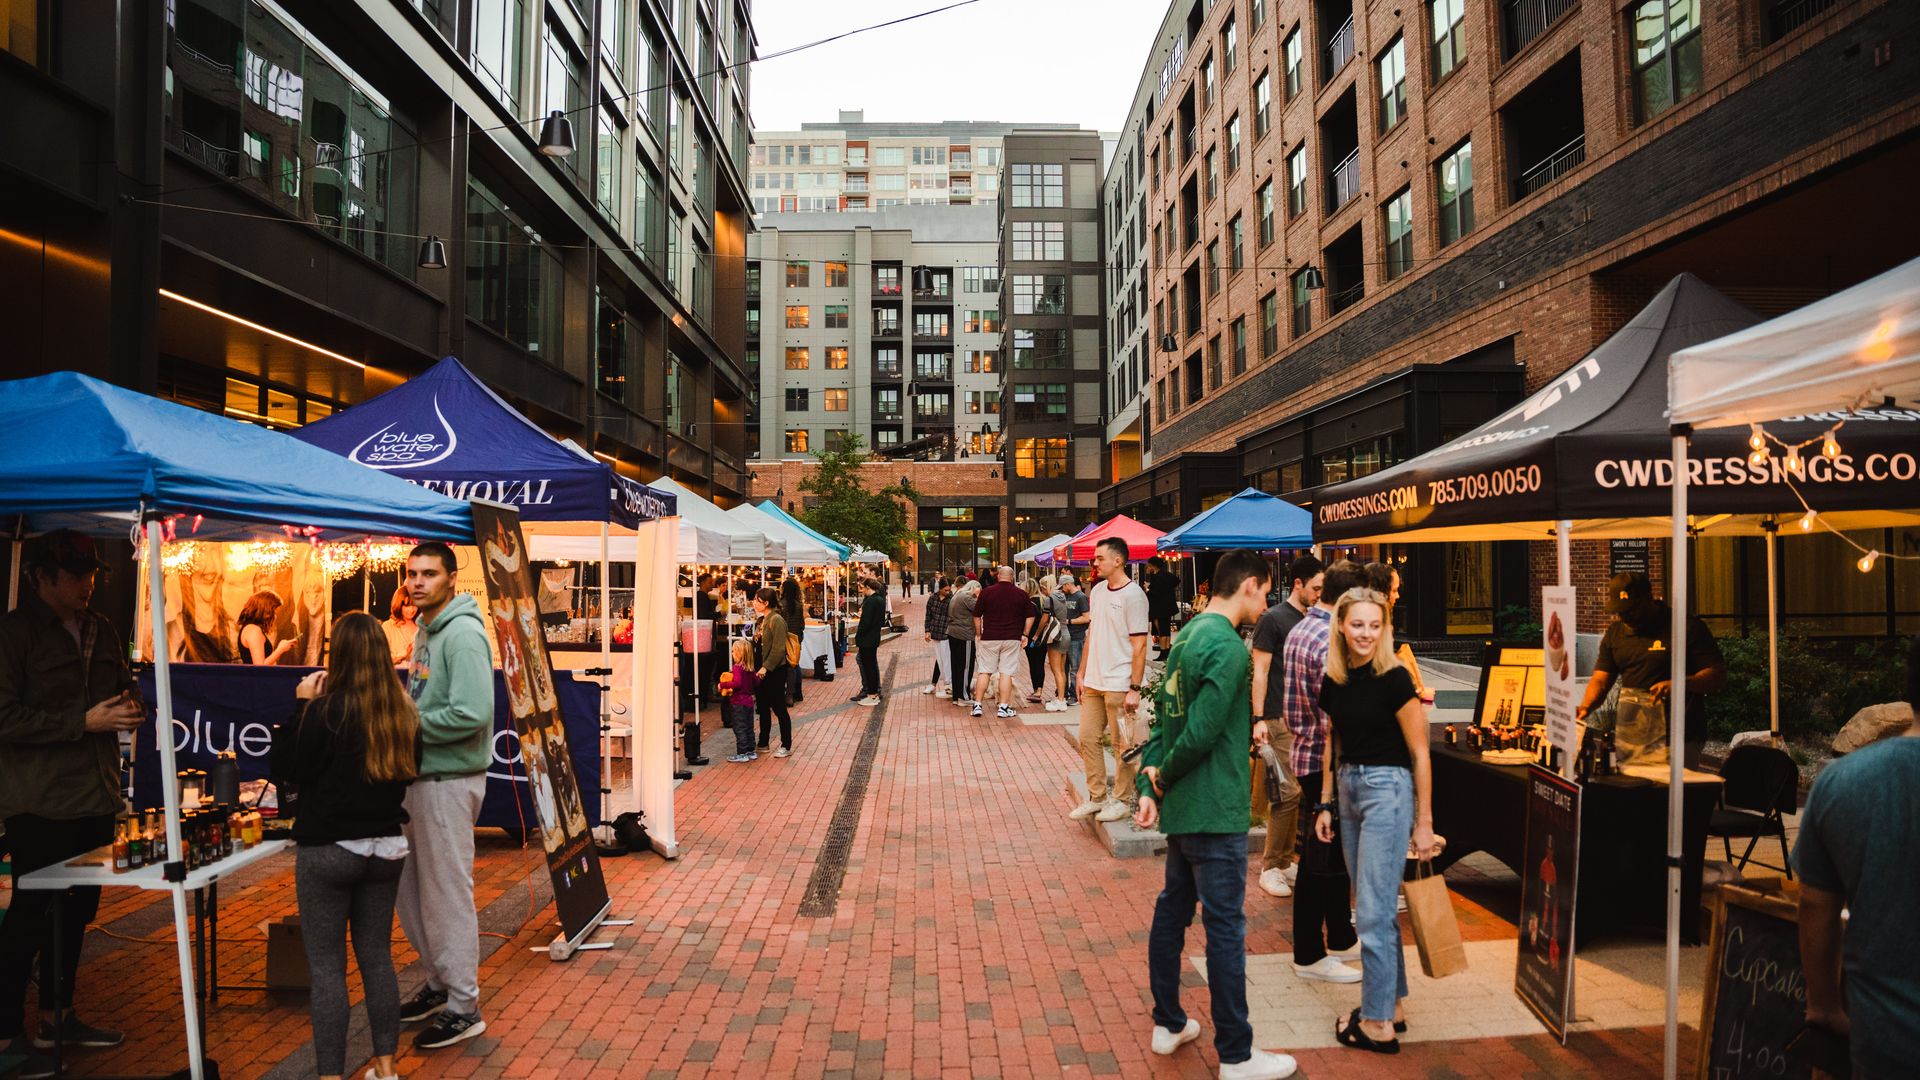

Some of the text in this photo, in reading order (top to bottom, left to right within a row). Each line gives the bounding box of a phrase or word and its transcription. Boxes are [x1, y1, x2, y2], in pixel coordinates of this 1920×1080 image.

[374, 441, 443, 452] water
[380, 432, 435, 444] blue
[366, 452, 417, 462] spa
[1594, 452, 1920, 489] CWDRESSINGS.CO
[404, 479, 553, 505] EMOVAL
[1319, 464, 1541, 524] CWDRESSINGS.COM 785.709.0050
[156, 709, 272, 757] blue
[1533, 780, 1553, 802] SWEET
[1553, 789, 1572, 813] DATE
